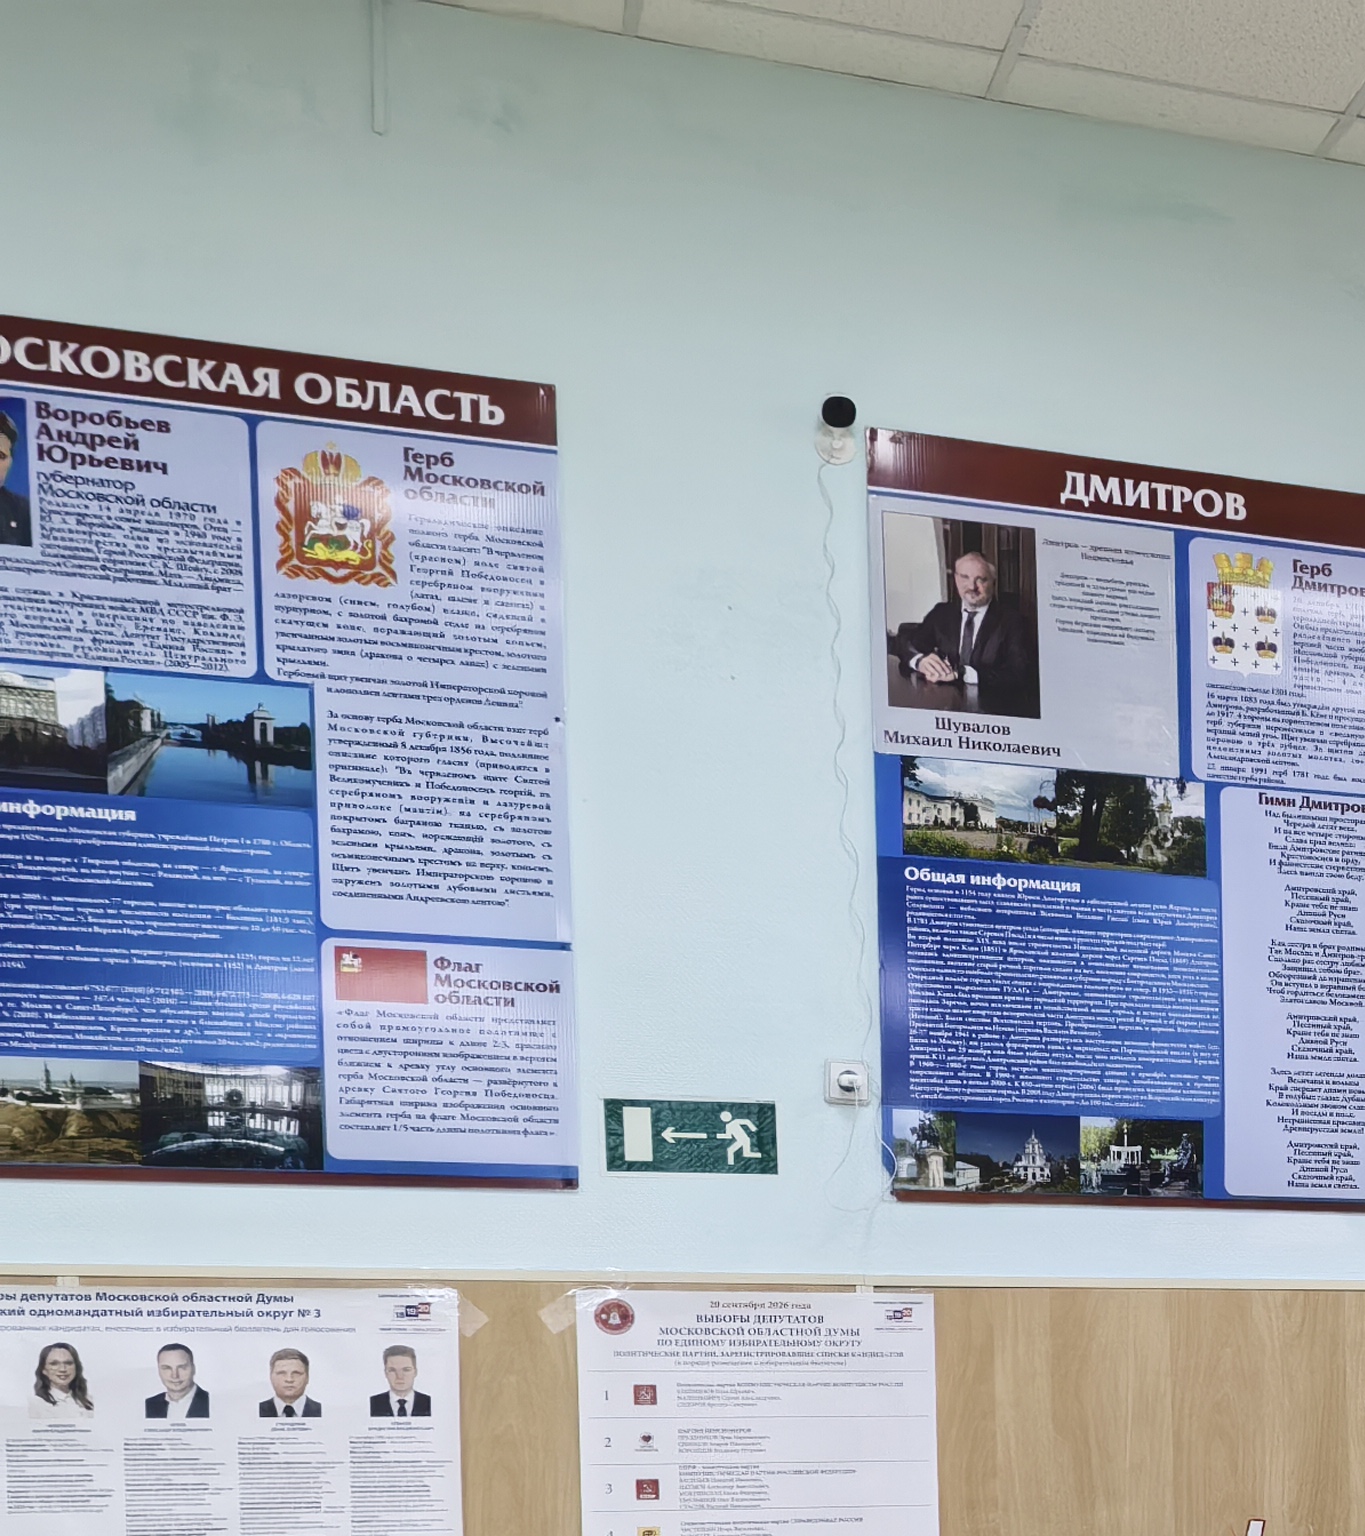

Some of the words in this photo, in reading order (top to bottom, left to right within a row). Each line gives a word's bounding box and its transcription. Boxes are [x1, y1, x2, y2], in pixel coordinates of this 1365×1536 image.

[294, 371, 506, 427] ОБЛАСТЬ
[34, 400, 171, 434] Воробьев
[36, 422, 140, 452] Андрей
[37, 443, 169, 476] Юрьевич
[403, 446, 455, 469] Герб
[37, 470, 135, 493] губернатор
[403, 465, 546, 496] Московской
[38, 483, 146, 507] Московской
[150, 497, 218, 515] области
[404, 486, 495, 509] области
[1060, 470, 1247, 521] ДМИТРОВ
[1292, 558, 1332, 579] Герб
[935, 716, 1011, 736] Шувалов
[883, 730, 952, 748] Михаил
[959, 735, 1061, 757] Николаевич
[1258, 792, 1296, 807] Гимн
[904, 866, 966, 886] Общая
[970, 872, 1081, 894] информация
[433, 956, 483, 974] Флаг
[434, 973, 561, 994] Московской
[434, 991, 515, 1007] области
[20, 1292, 92, 1304] депутатов
[96, 1291, 179, 1302] Московской
[182, 1292, 253, 1303] областной
[255, 1293, 294, 1304] Думы
[710, 1301, 720, 1309] 20
[721, 1301, 766, 1311] сентября
[767, 1301, 790, 1310] 2026
[791, 1302, 812, 1311] года
[29, 1307, 144, 1319] одномандатный
[147, 1307, 253, 1319] избирательный
[257, 1309, 294, 1320] округ
[297, 1308, 312, 1318] №
[314, 1309, 322, 1319] 3
[696, 1313, 750, 1324] ВЫБОРЫ
[752, 1314, 825, 1325] ДЕПУТАТОВ
[658, 1325, 746, 1337] МОСКОВСКОЙ
[747, 1326, 822, 1338] ОБЛАСТНОЙ
[824, 1327, 861, 1338] ДУМЫ
[657, 1338, 673, 1347] ПО
[674, 1338, 726, 1348] ЕДИНОМУ
[728, 1338, 823, 1348] ИЗБИРАТЕЛЬНОМУ
[824, 1339, 863, 1348] ОКРУГУ
[603, 1390, 610, 1401] 1
[603, 1437, 612, 1448] 2
[604, 1483, 613, 1495] 3
